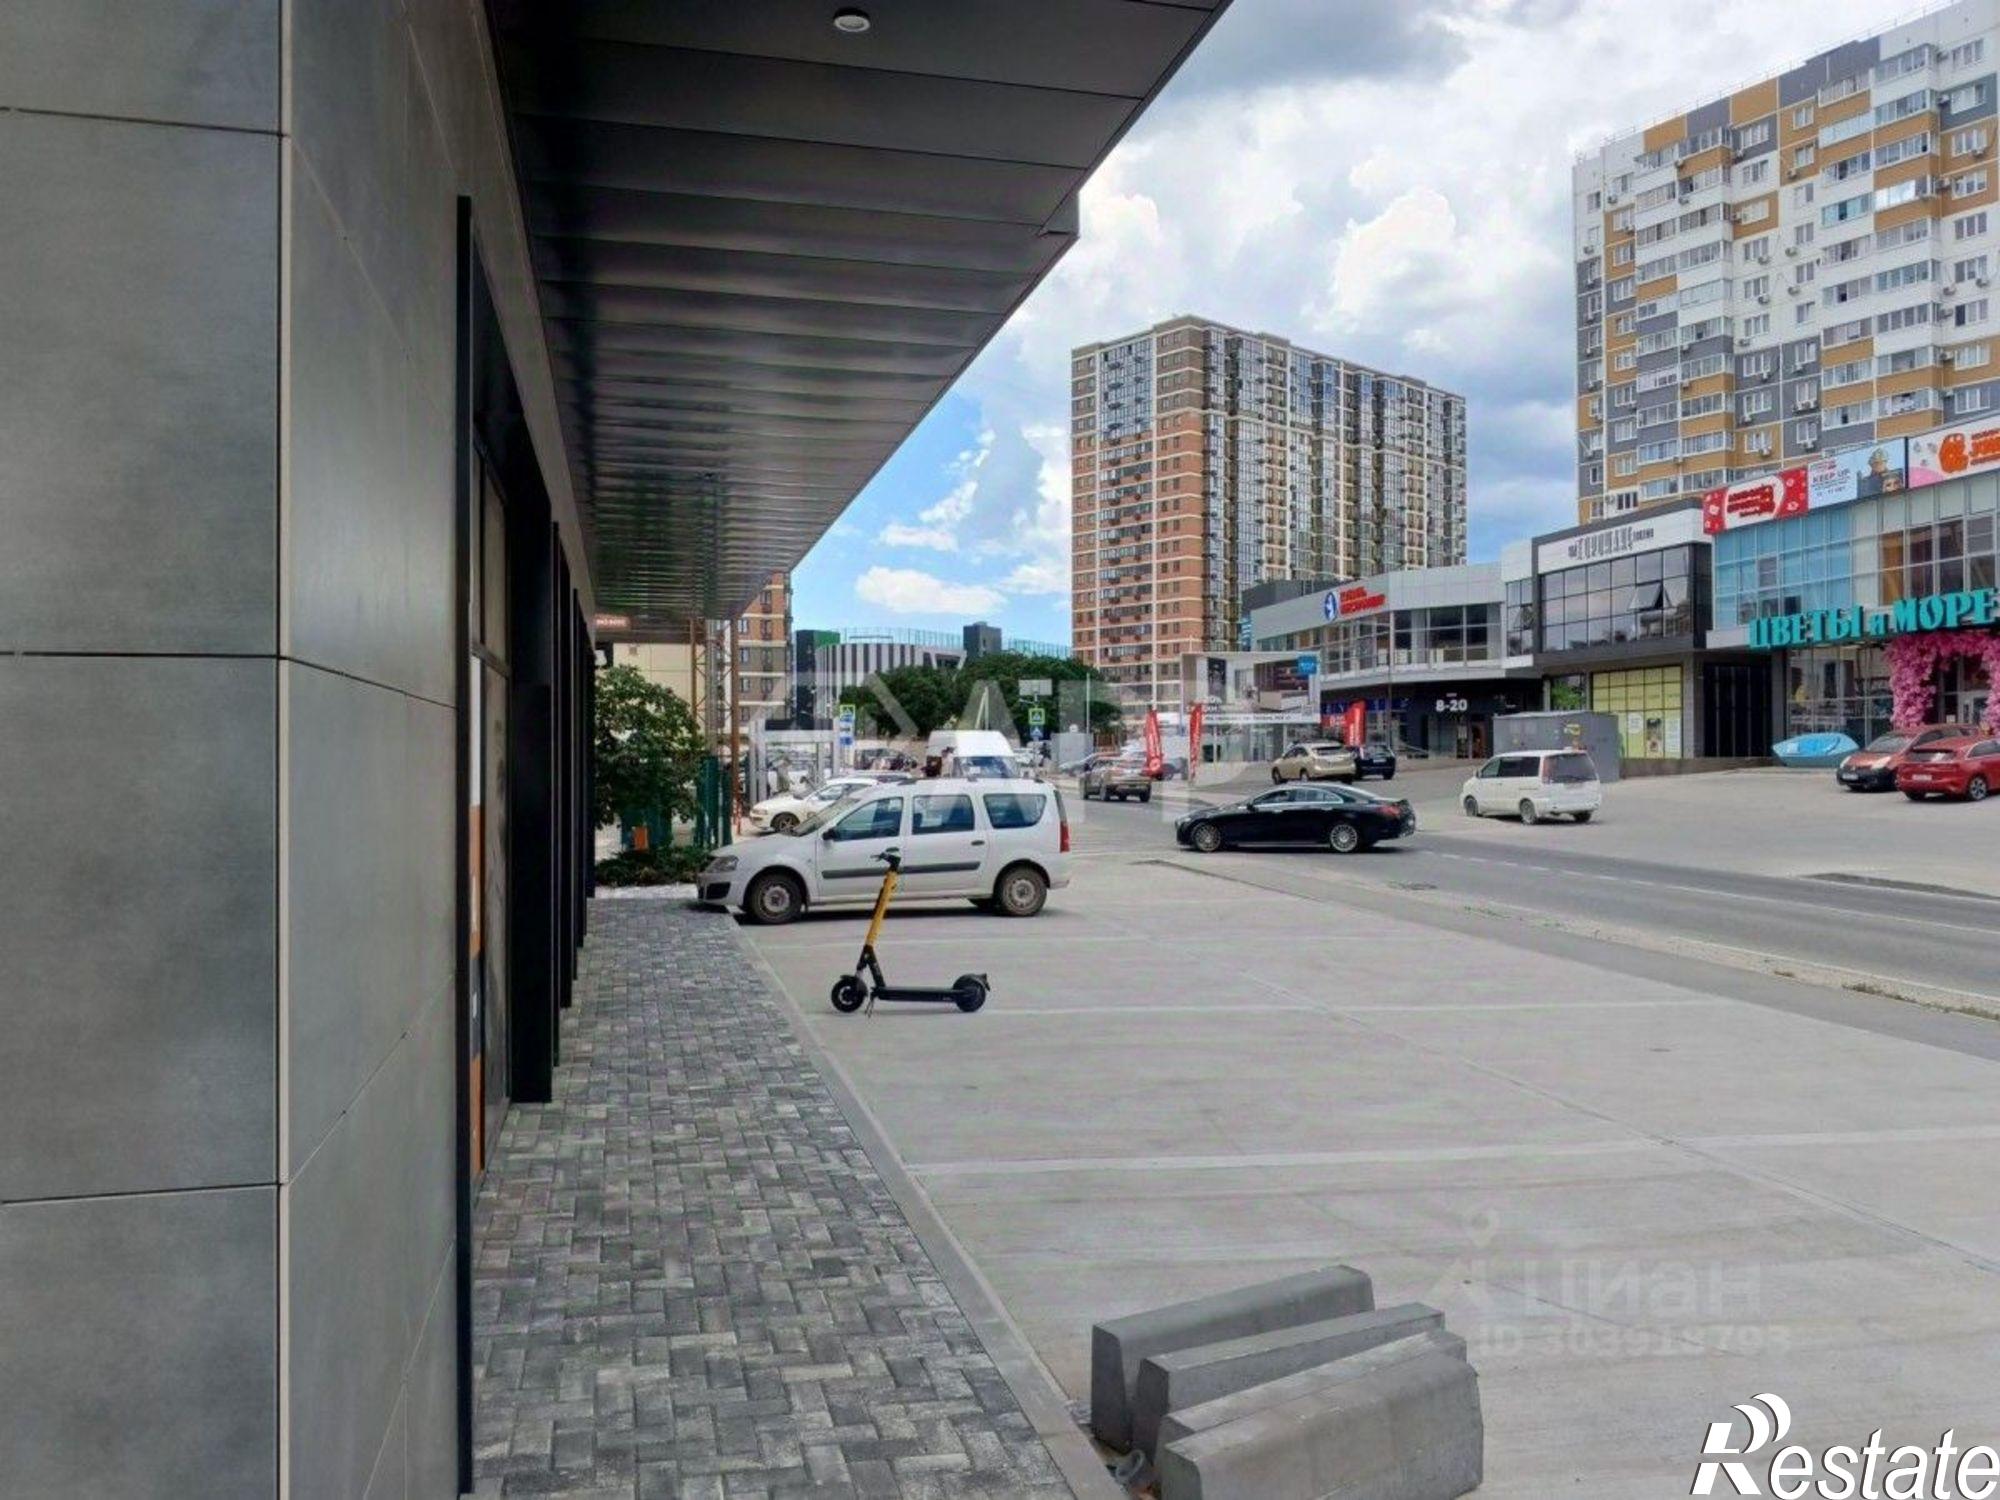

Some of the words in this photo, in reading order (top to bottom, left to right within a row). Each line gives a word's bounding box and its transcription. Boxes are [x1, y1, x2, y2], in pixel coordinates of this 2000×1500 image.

[1749, 604, 1864, 649] ЦВЕТЫ
[1893, 587, 1997, 633] МОРЕ
[1435, 698, 1468, 712] 8-20
